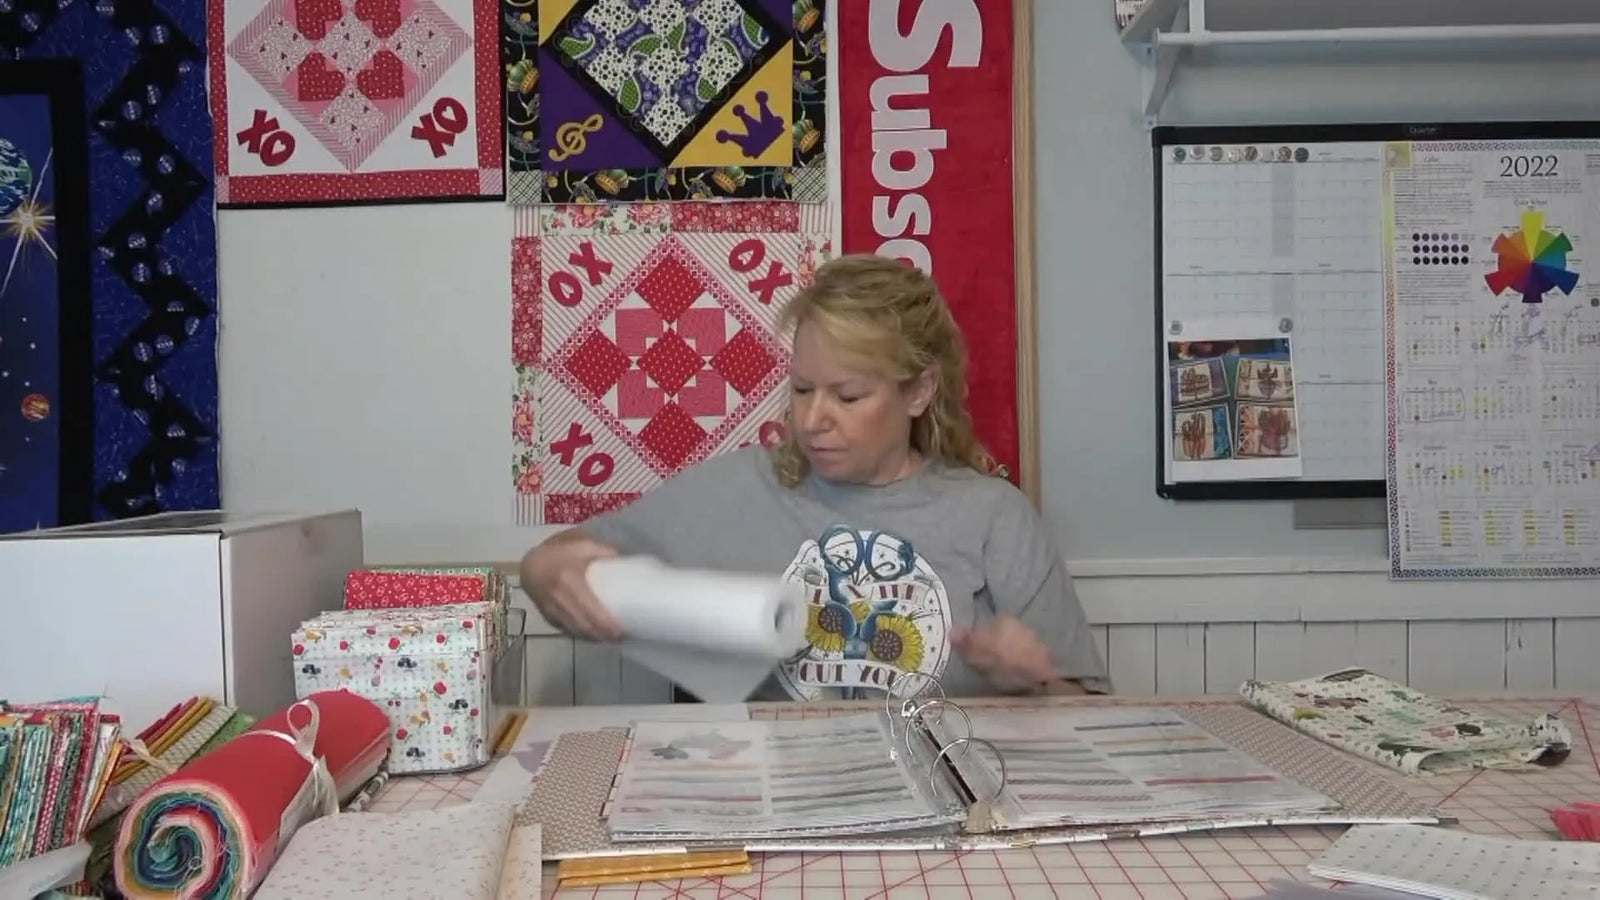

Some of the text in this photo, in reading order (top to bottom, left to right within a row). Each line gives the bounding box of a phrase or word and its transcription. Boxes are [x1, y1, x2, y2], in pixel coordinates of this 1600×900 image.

[238, 110, 294, 165] XO
[412, 97, 468, 156] XO
[1500, 155, 1558, 177] 2022
[549, 422, 615, 487] XO
[799, 662, 847, 684] CUT
